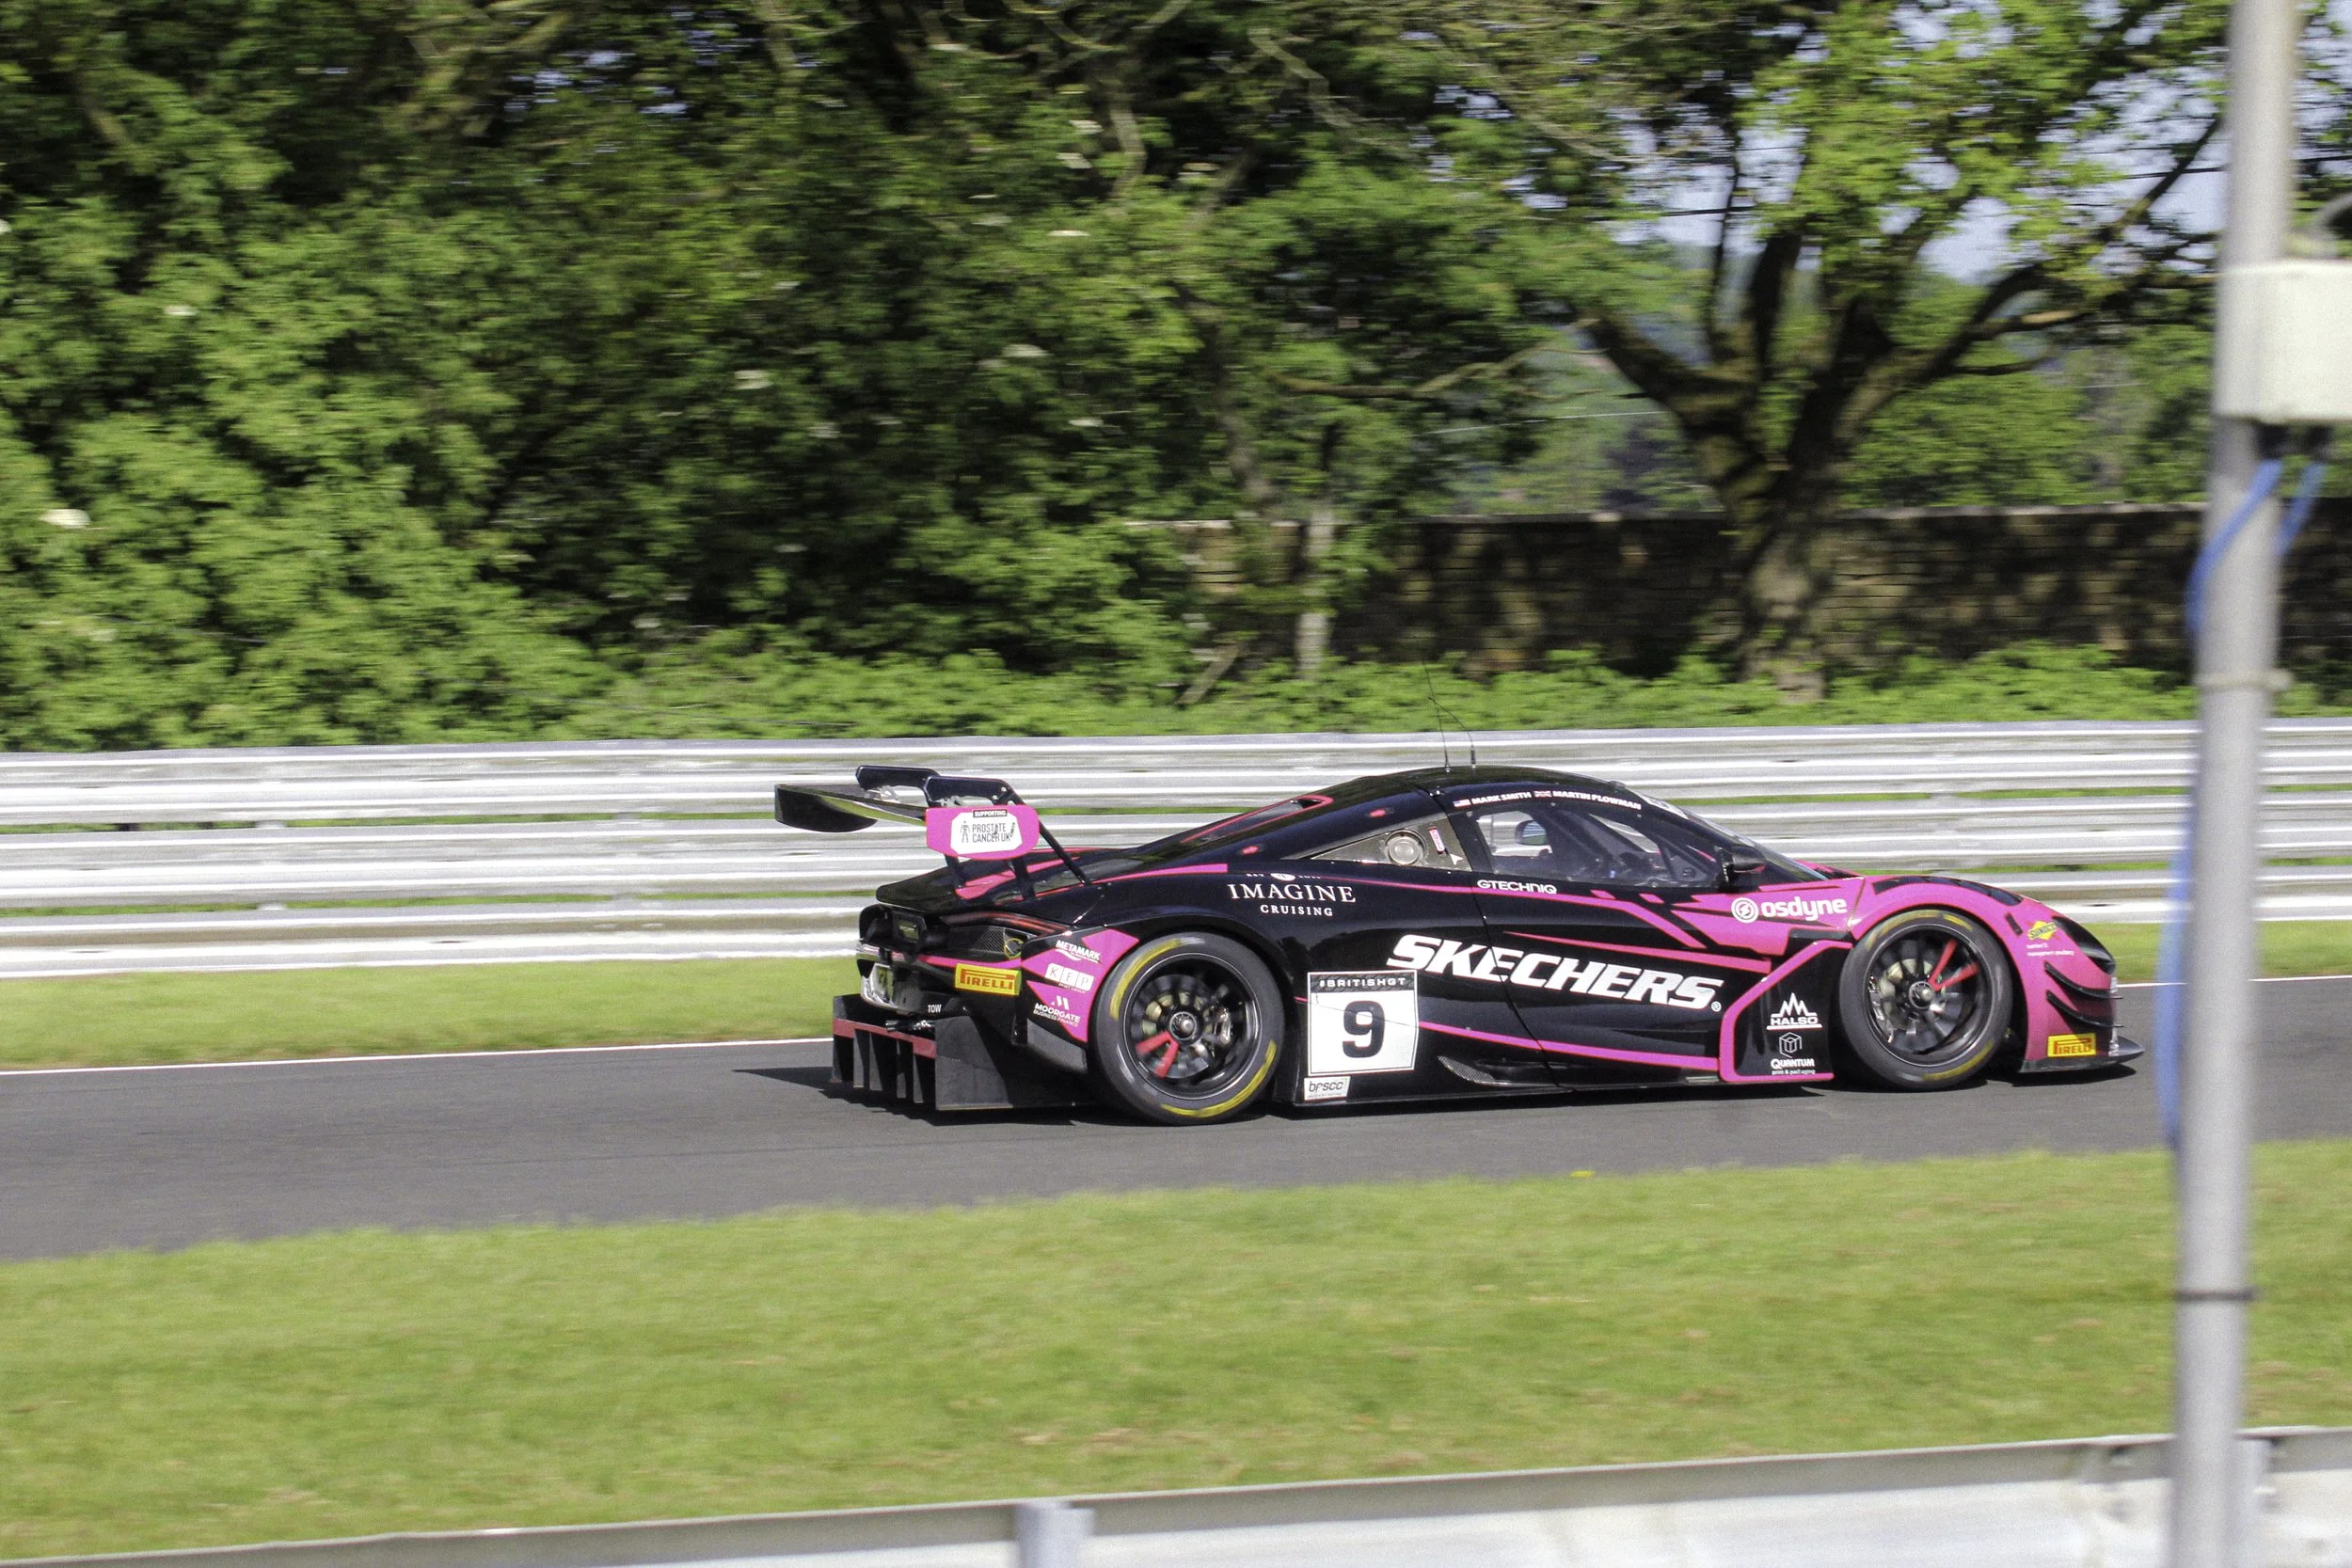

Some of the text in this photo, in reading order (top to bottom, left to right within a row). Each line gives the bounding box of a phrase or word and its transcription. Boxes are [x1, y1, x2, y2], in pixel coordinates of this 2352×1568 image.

[1470, 791, 1532, 805] MARK SMITH
[1552, 790, 1642, 810] MARTIN PLOWMAN
[972, 822, 1007, 833] PROSTATE
[972, 832, 1010, 843] CANCER UK
[1227, 883, 1357, 903] IMAGINE
[1477, 879, 1558, 895] GTECHNIQ
[1260, 904, 1333, 917] CRUISING
[1760, 896, 1848, 921] osdyne
[1056, 940, 1101, 961] METAMARK
[960, 968, 1016, 990] PIRELLI
[1387, 934, 1724, 1010] SKECHERS
[1319, 977, 1406, 988] #BRITISHGT
[928, 1004, 942, 1013] TOW
[1035, 1003, 1081, 1023] MOORGATE
[1057, 1016, 1079, 1027] FINANCE
[1770, 1016, 1819, 1025] HALSO
[1343, 1000, 1385, 1058] 9
[2053, 1037, 2092, 1054] PIRELLI
